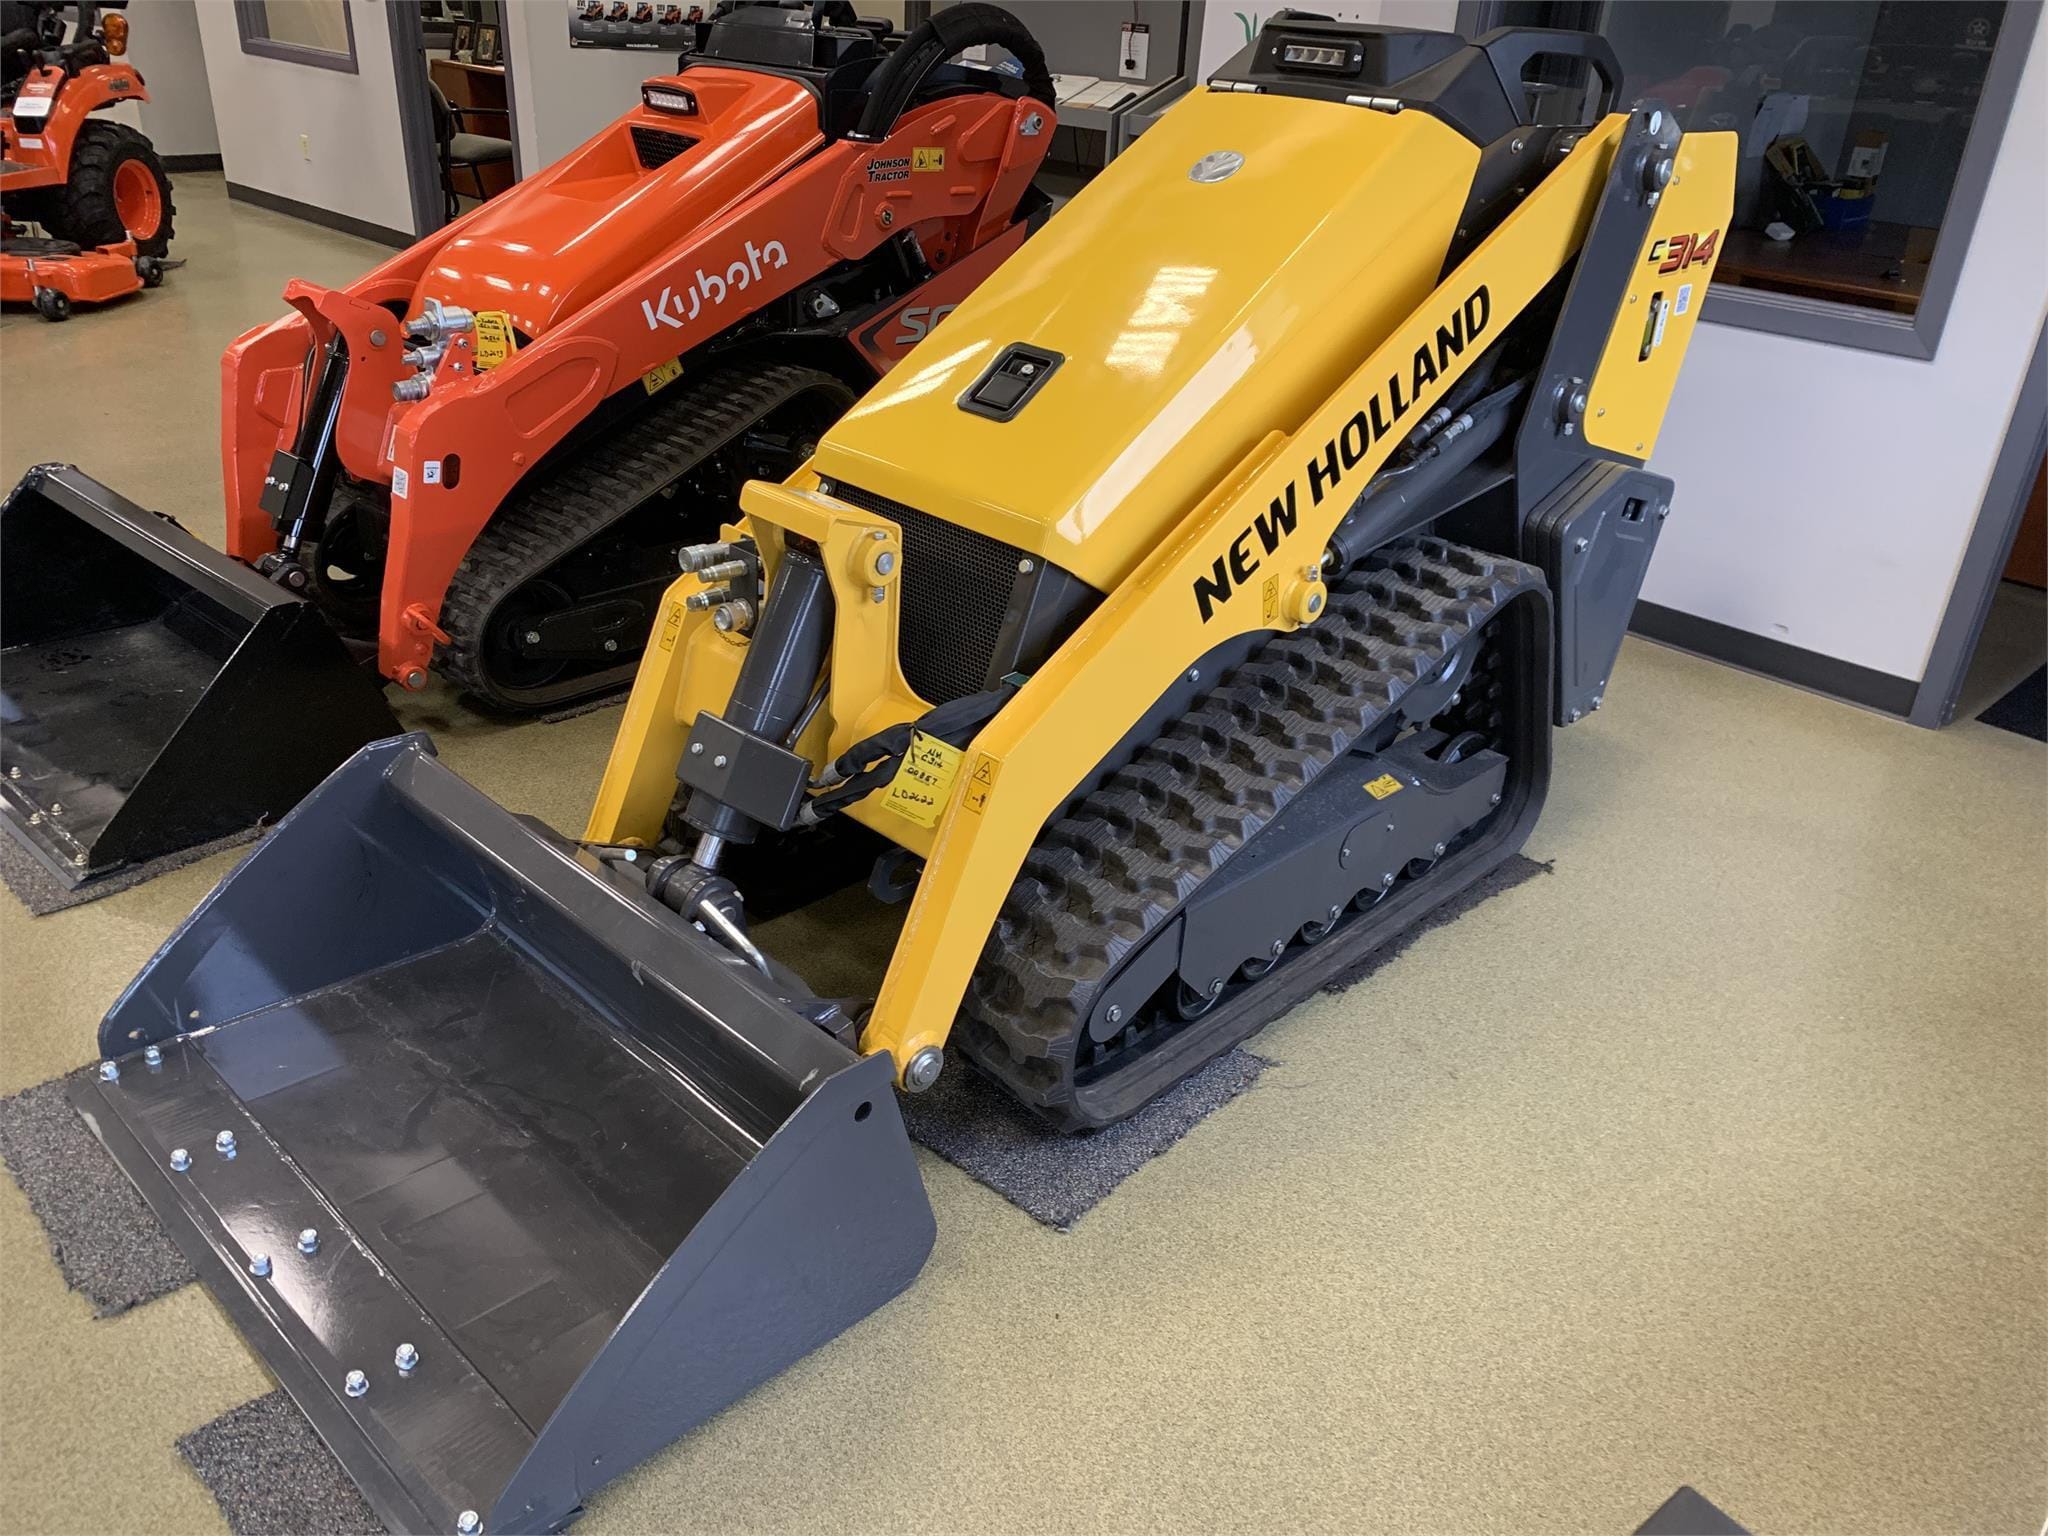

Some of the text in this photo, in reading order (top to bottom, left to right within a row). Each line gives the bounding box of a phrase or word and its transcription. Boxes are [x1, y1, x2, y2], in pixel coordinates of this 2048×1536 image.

[867, 157, 910, 170] JOHNSON
[868, 171, 910, 183] TRACTOR
[1648, 229, 1720, 275] C314
[641, 239, 788, 331] Kubota
[1193, 284, 1490, 624] NEW HOLLAND
